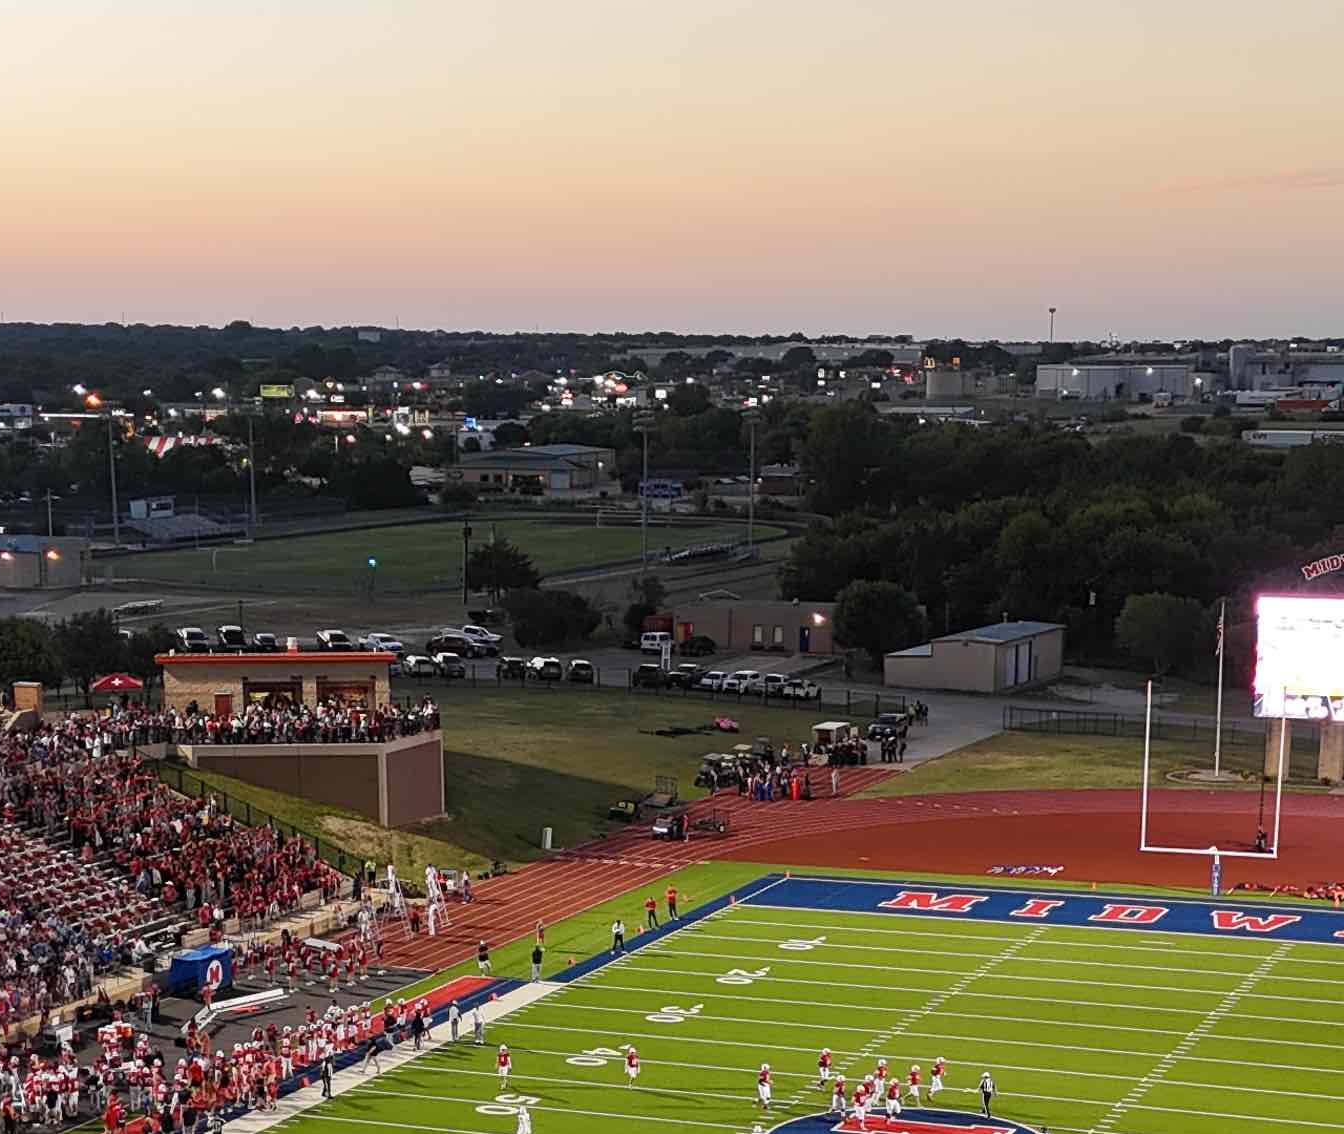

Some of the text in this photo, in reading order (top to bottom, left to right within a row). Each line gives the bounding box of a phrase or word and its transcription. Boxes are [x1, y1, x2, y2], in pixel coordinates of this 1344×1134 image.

[777, 938, 824, 951] 10
[715, 968, 768, 985] 20
[645, 1005, 701, 1023] 30
[565, 1047, 623, 1067] 40
[475, 1093, 542, 1116] 50
